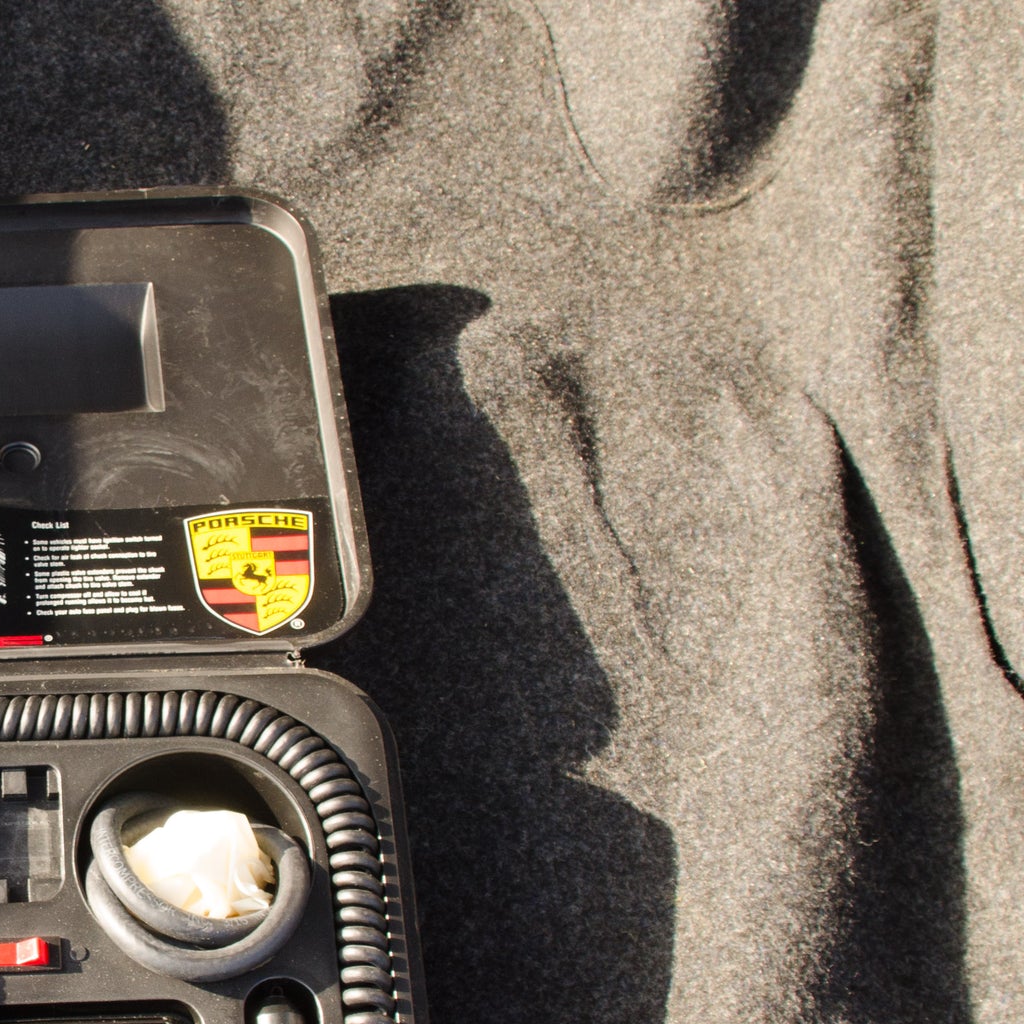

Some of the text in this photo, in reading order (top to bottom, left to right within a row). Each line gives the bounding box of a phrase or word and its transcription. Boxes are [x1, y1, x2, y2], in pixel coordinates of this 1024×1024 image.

[31, 521, 69, 529] Check List
[193, 516, 305, 532] PORSCHE
